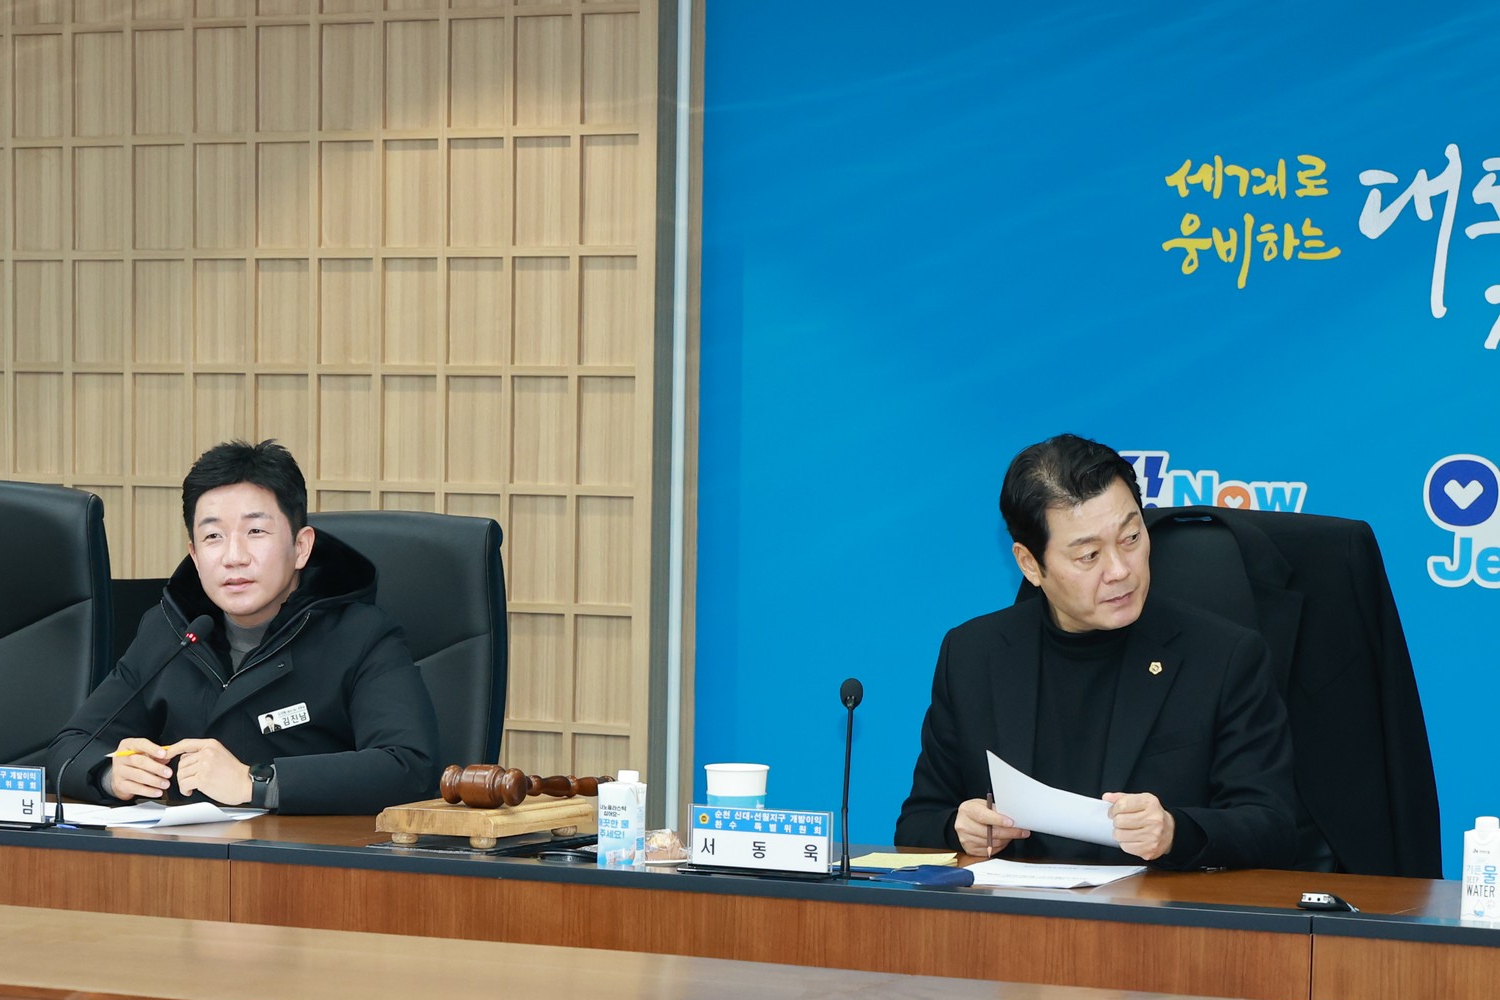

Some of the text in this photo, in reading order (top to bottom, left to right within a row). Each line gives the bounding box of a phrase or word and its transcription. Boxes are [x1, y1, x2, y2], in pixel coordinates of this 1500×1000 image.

[1164, 154, 1329, 200] 세계로
[282, 712, 307, 726] 김진남
[10, 771, 36, 780] 개발이익
[714, 810, 730, 819] 순천
[789, 814, 822, 825] 개발이익
[1466, 885, 1496, 898] WATER
